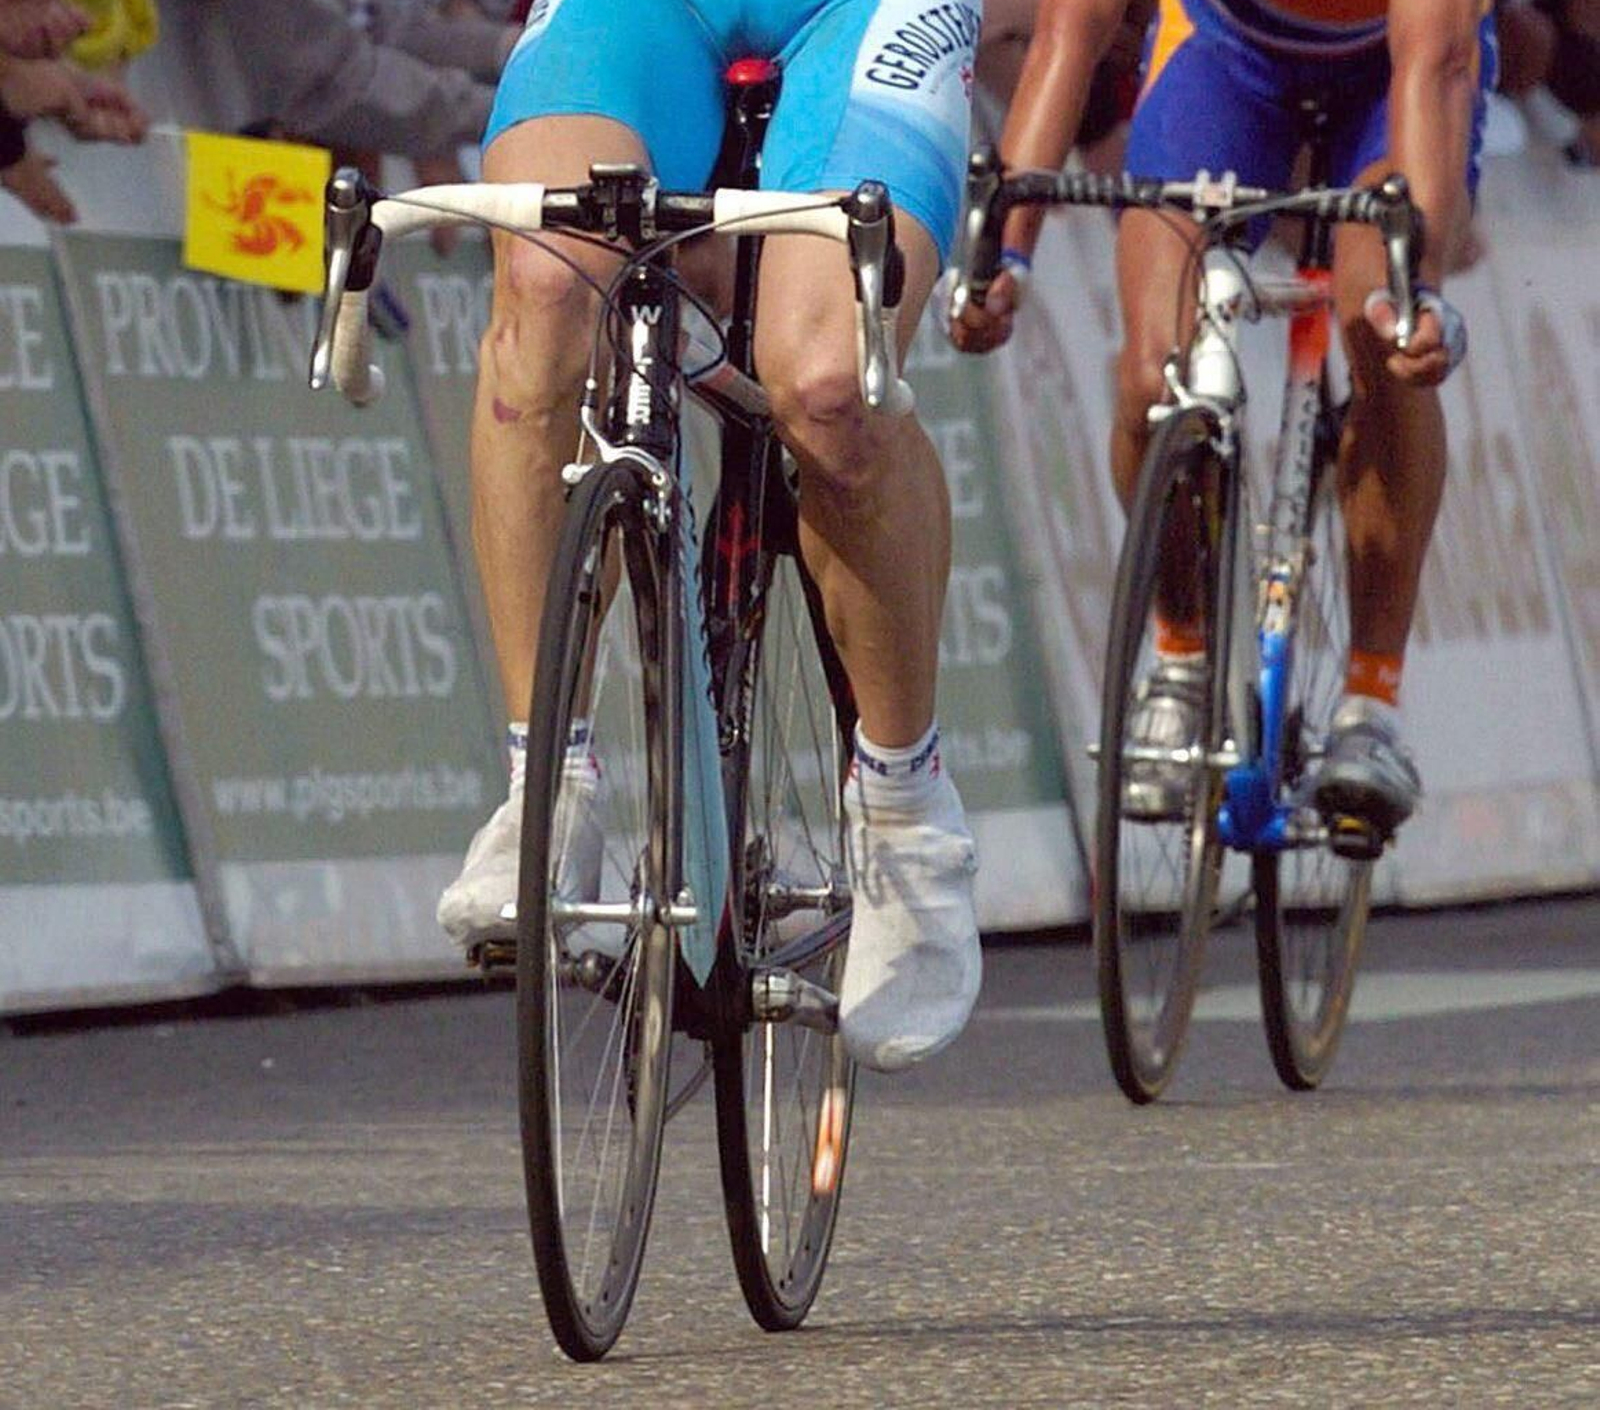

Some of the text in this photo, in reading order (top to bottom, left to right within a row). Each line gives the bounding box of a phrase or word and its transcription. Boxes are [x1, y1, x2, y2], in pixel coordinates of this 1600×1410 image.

[168, 435, 423, 541] DE LIEGE
[252, 594, 458, 702] SPORTS
